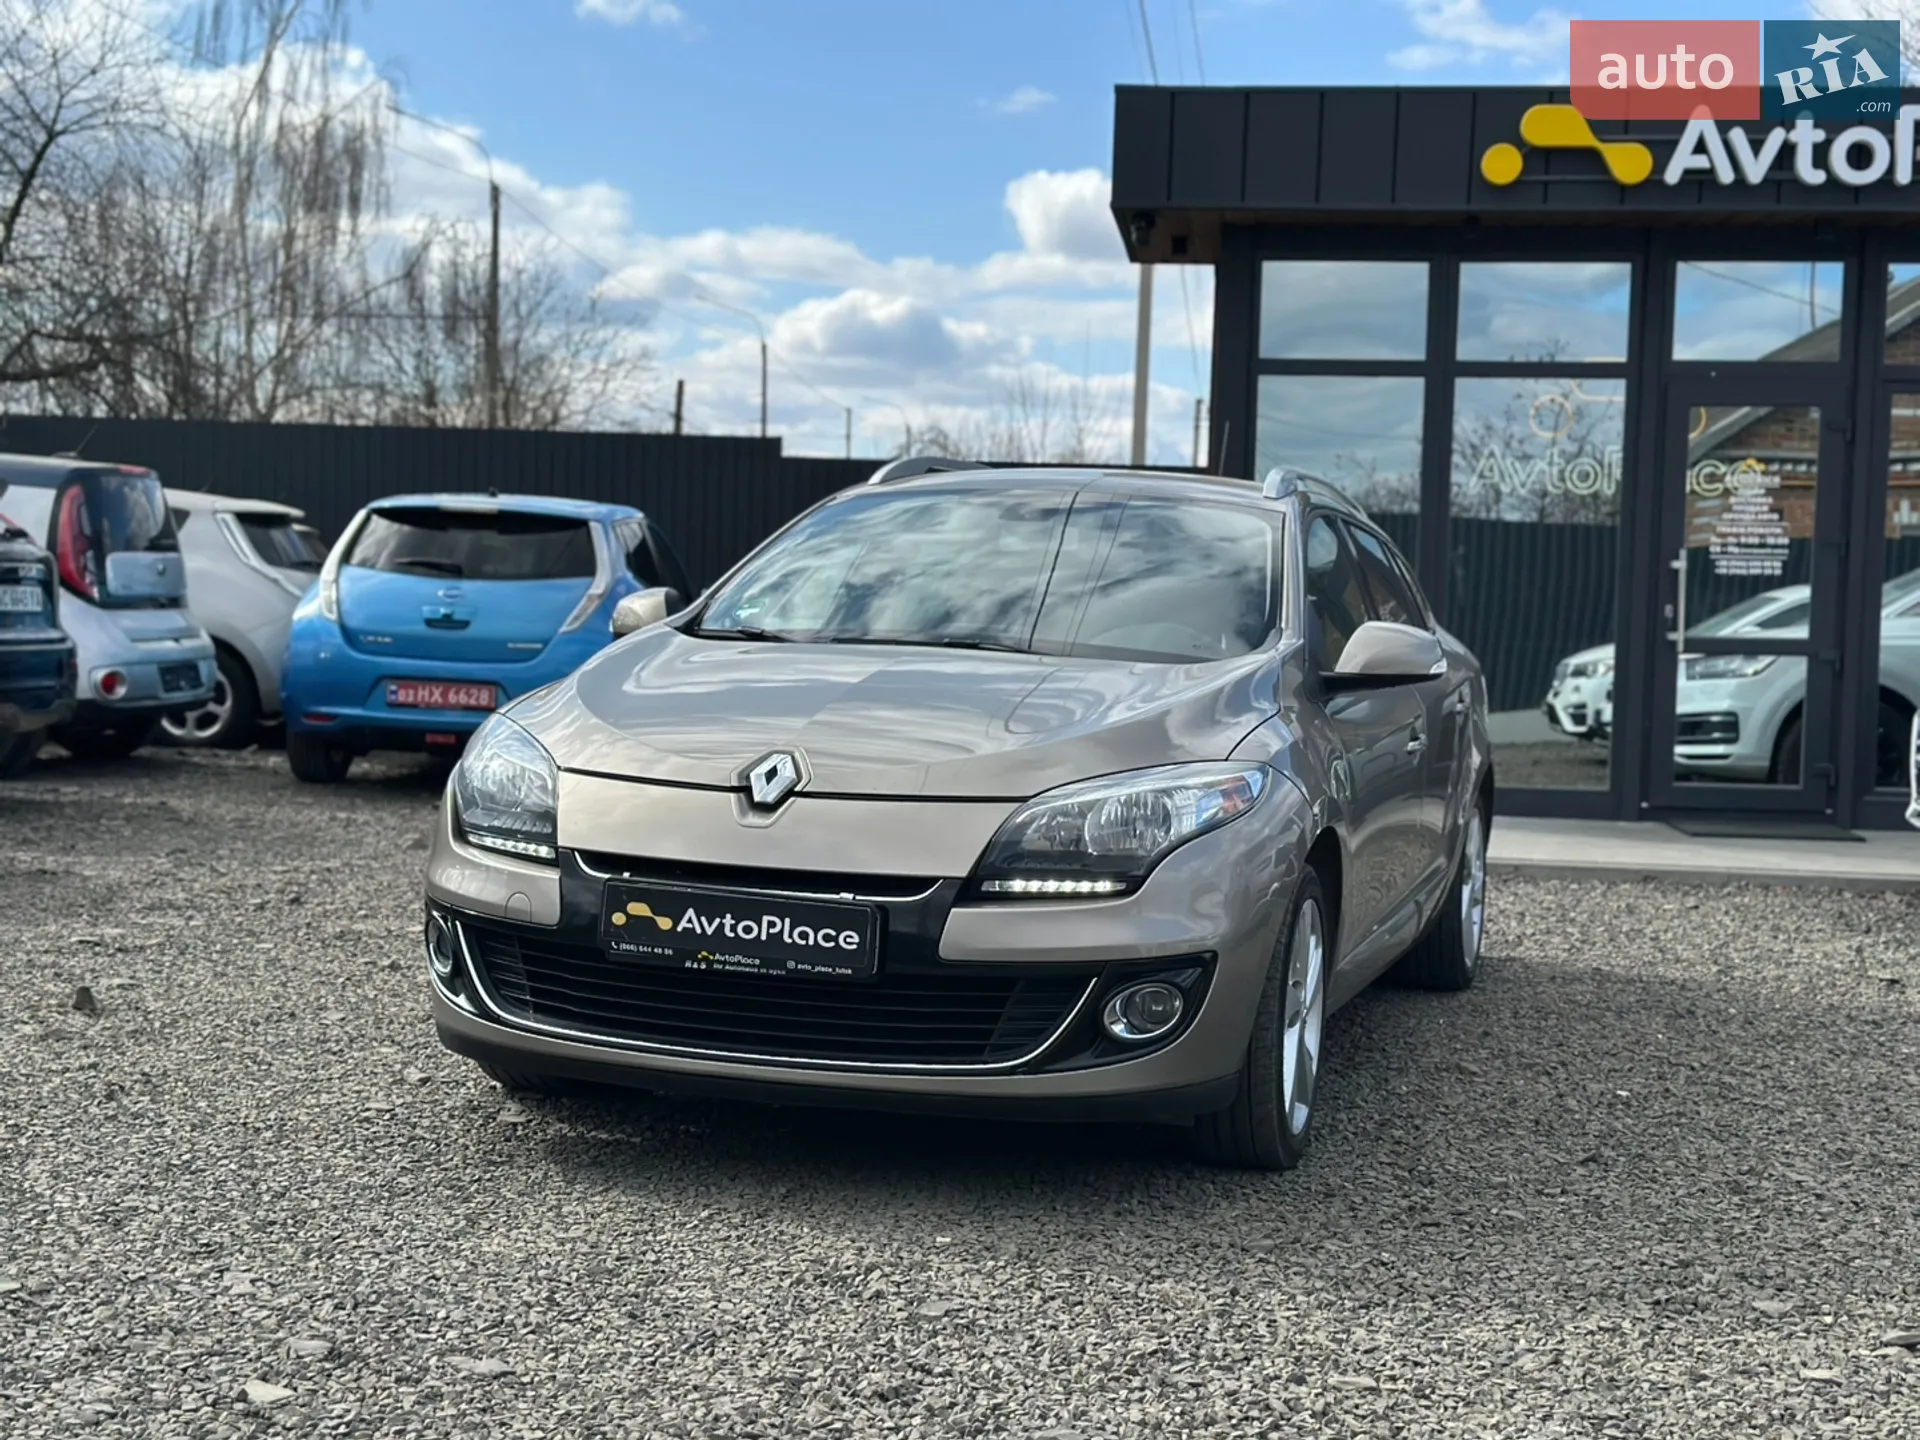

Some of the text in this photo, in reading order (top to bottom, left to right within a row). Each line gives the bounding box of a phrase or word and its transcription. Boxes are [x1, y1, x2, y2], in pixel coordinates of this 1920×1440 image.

[448, 688, 490, 705] 6628
[676, 907, 860, 950] AvtoPlace
[714, 953, 760, 966] AvtoPlace
